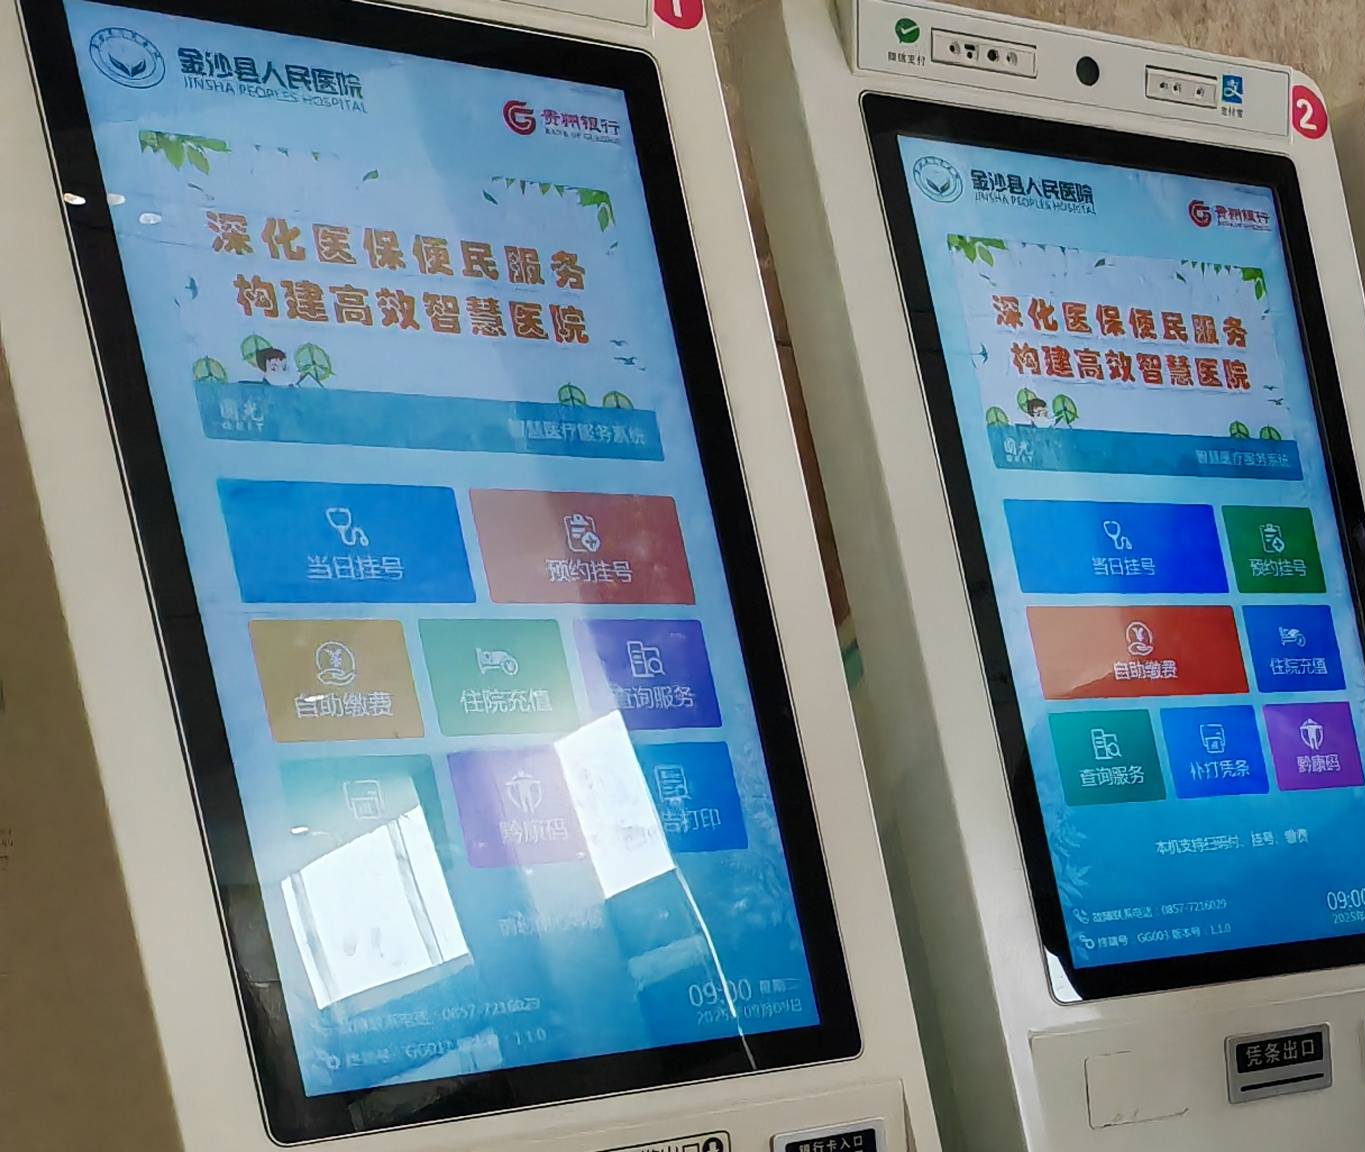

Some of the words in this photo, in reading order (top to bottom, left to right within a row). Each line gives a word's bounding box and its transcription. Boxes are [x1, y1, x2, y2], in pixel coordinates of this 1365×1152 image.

[178, 47, 363, 100] 金沙县人民医院
[1296, 98, 1318, 131] 2
[970, 168, 1094, 205] 金沙县人民医院
[205, 211, 587, 294] 深化医保便民服务
[233, 274, 591, 345] 构建高效智慧医院
[991, 294, 1248, 348] 深化医保便民服务
[1010, 342, 1252, 391] 构建高效智慧医院
[307, 554, 404, 581] 当日挂号
[546, 560, 633, 583] 预约挂号
[1092, 557, 1156, 577] 当日挂号
[293, 693, 394, 719] 自助缴费
[460, 687, 553, 715] 住院充值
[1080, 764, 1145, 787] 查询服务
[1245, 1037, 1318, 1068] 凭条出口
